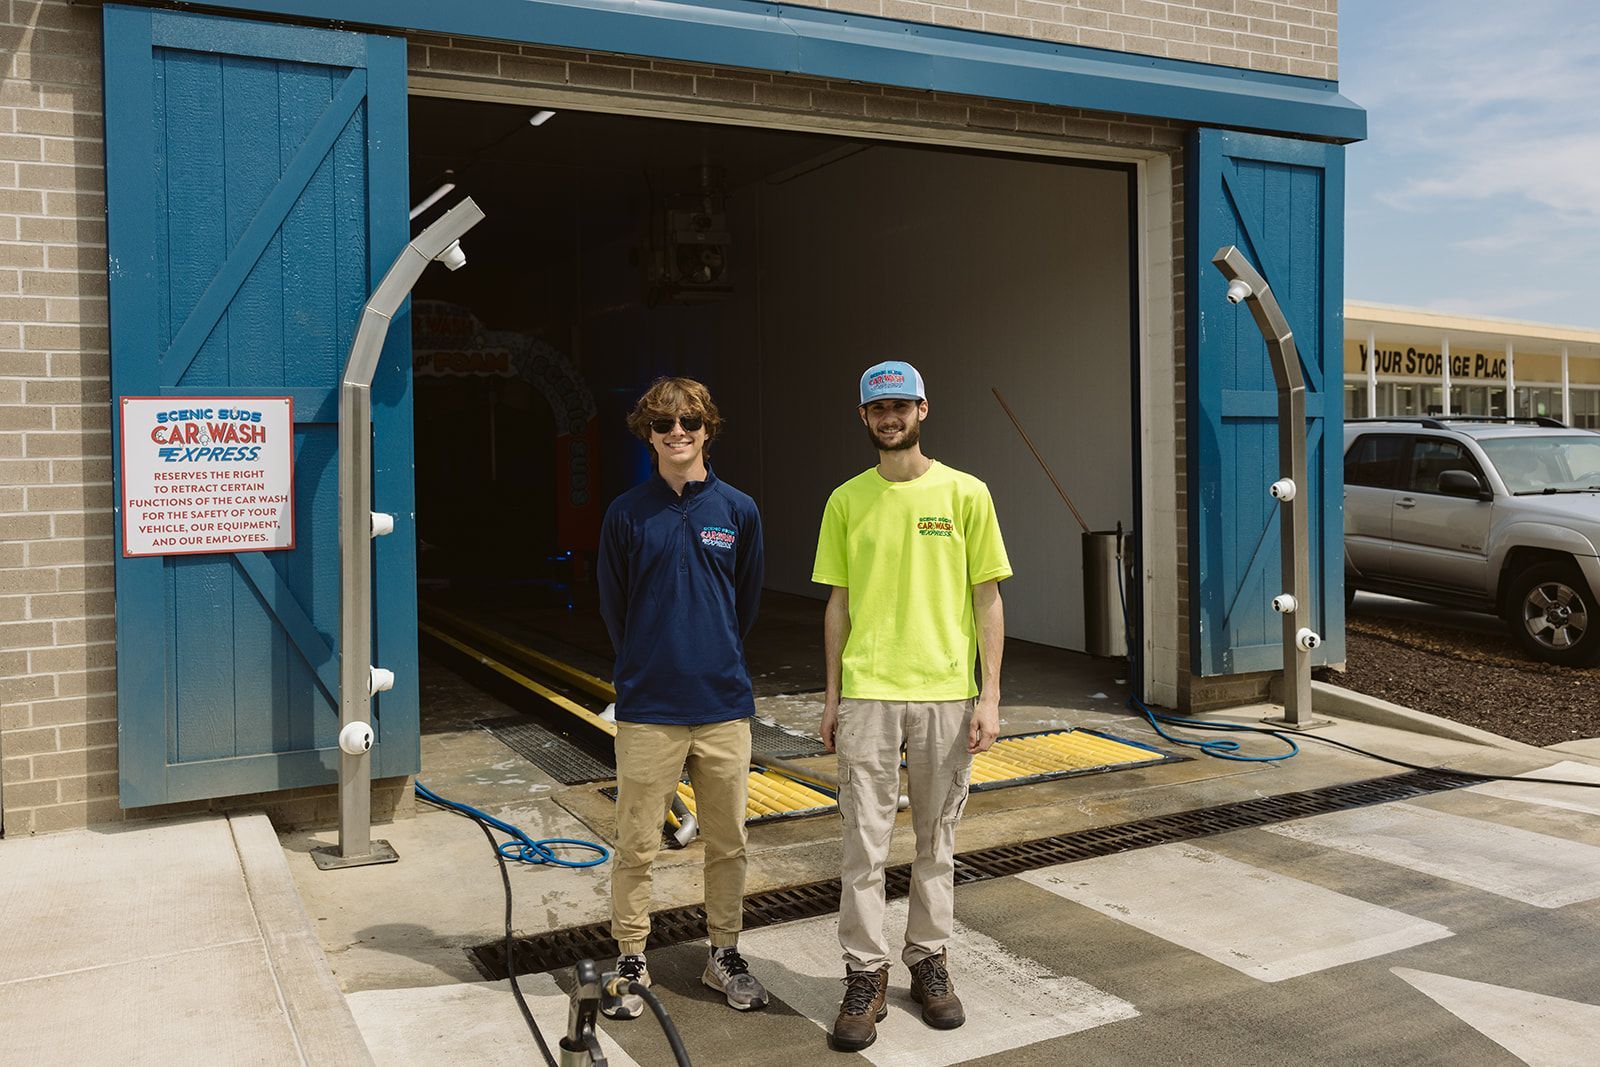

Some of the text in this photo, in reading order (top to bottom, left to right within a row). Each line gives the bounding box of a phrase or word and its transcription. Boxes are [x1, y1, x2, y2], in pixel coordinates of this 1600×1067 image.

[433, 352, 508, 373] FOAM
[1406, 347, 1470, 378] STORGE
[1475, 353, 1515, 379] PLAC
[156, 408, 262, 423] SCENIC SUDS
[151, 421, 266, 445] CAR WASH
[158, 446, 262, 463] EXPRESS
[154, 470, 265, 481] RESERVES THE RIGHT
[154, 483, 265, 494] TO RETRACT CERTAIN
[129, 495, 288, 508] FUNCTIONS OF THE CAR WASH
[142, 508, 277, 521] FOR THE SAFETY OF YOUR
[139, 520, 281, 534] VEHICLE, OUR EQUIPMENT,
[917, 522, 953, 531] CAR WASH
[152, 533, 269, 547] AND OUR EMPLOYEES.
[700, 531, 717, 540] CAR
